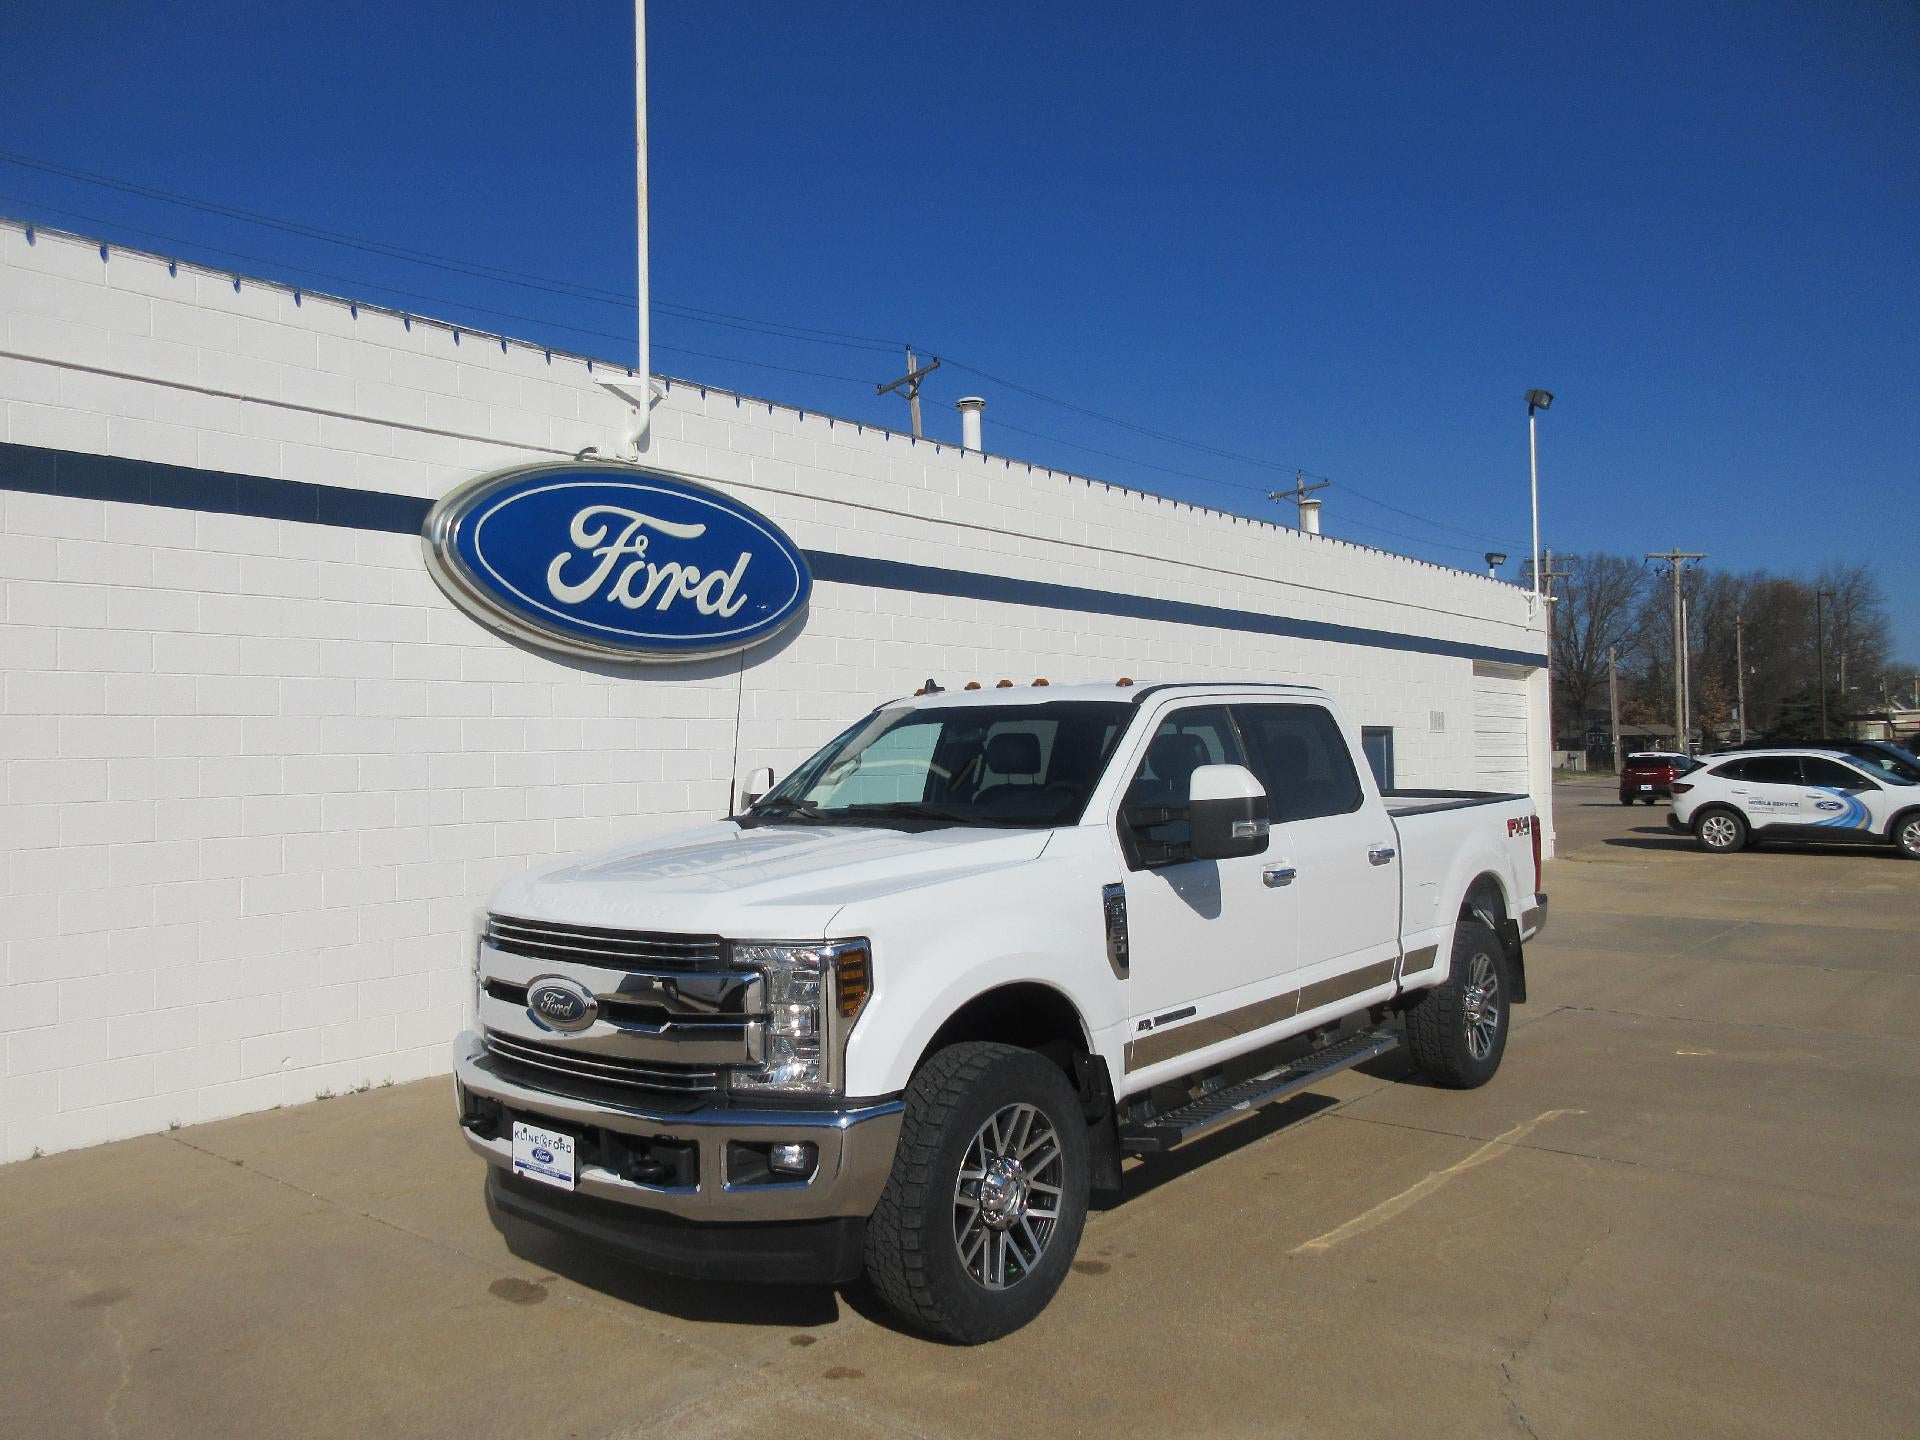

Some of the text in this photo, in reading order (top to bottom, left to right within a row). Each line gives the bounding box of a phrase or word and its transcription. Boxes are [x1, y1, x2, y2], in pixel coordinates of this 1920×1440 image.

[547, 505, 752, 618] Ford
[540, 991, 574, 1017] Ford
[514, 1130, 539, 1144] KLINE
[549, 1140, 572, 1154] FORD
